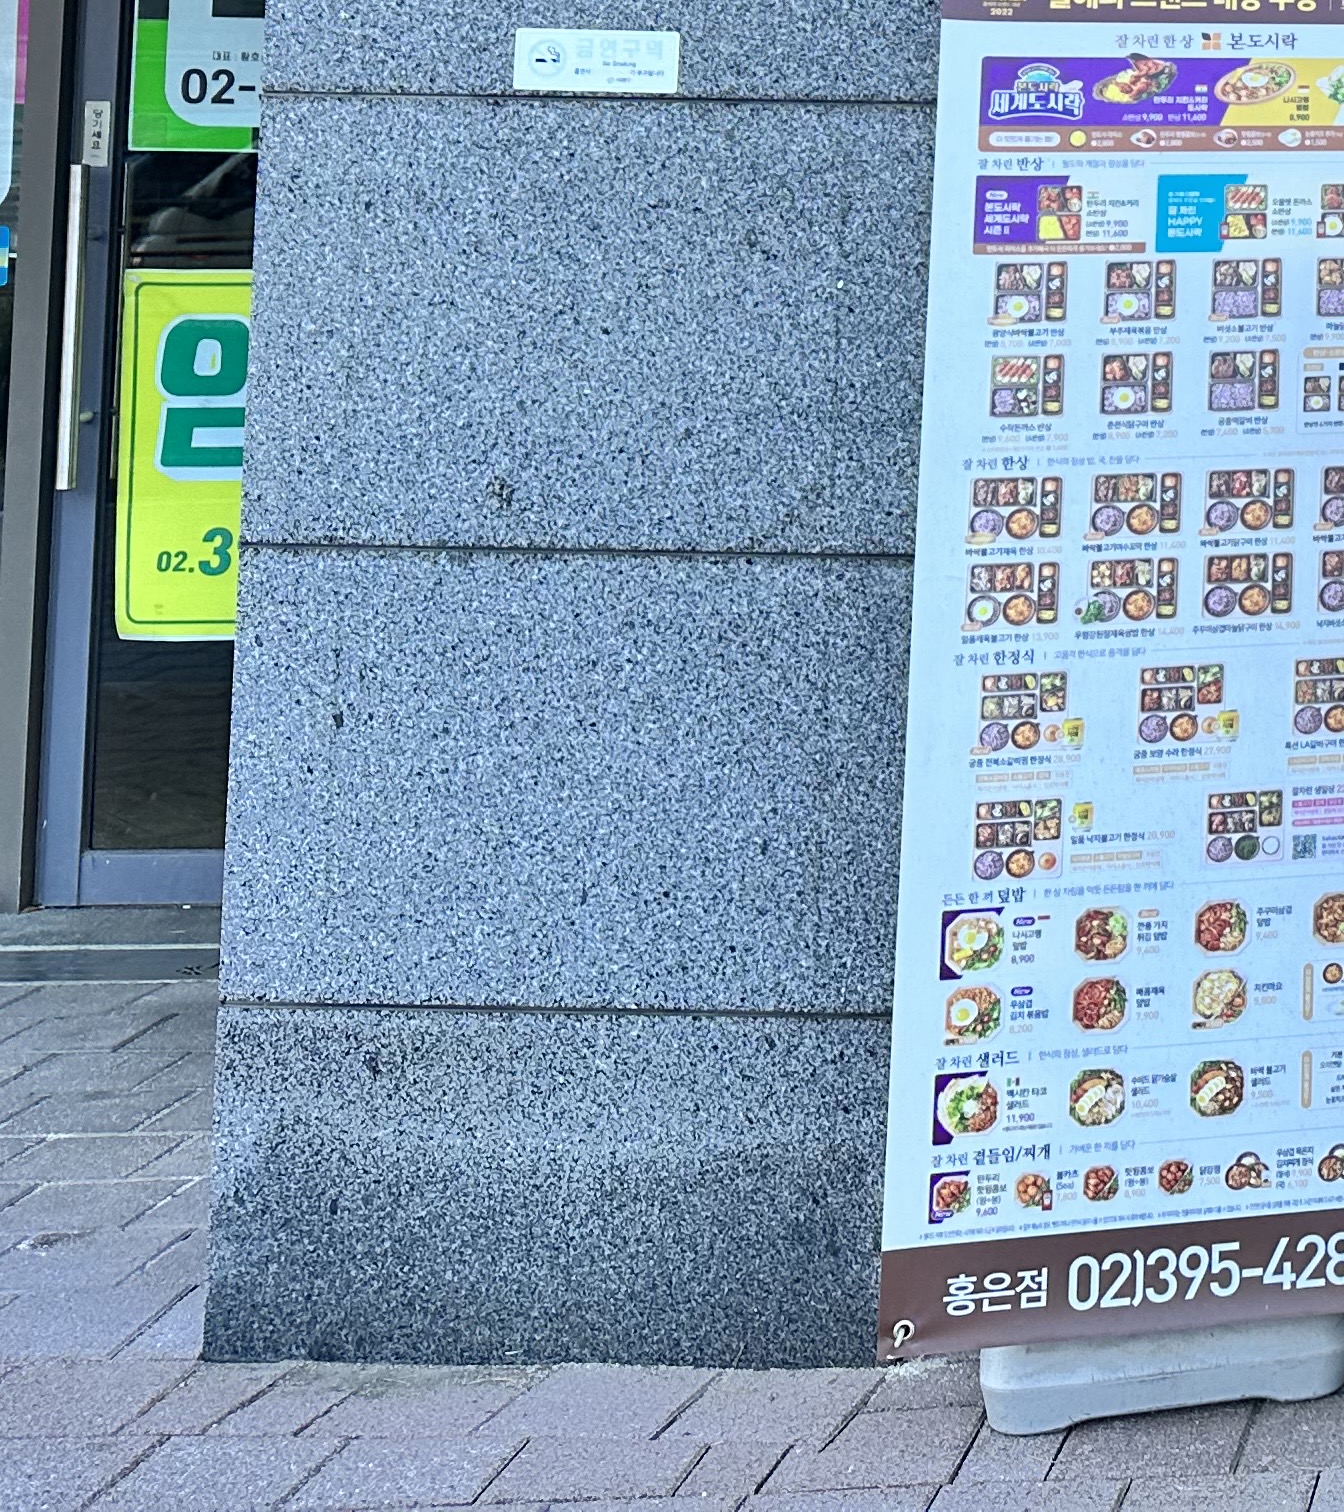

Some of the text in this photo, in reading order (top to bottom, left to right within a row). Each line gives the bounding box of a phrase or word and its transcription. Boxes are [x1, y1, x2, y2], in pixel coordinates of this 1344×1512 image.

[990, 7, 1014, 16] 2022
[1115, 34, 1129, 48] 잘
[1132, 33, 1159, 49] 차린
[1226, 32, 1298, 50] 본도시락
[992, 92, 1083, 117] 세계도시락
[992, 159, 1013, 171] 차린
[1016, 157, 1045, 172] 반상
[1167, 216, 1203, 227] HAPPY
[976, 458, 998, 471] 차린
[1001, 455, 1030, 471] 한상
[967, 653, 990, 665] 차린
[993, 649, 1035, 666] 한정식
[997, 886, 1027, 904] 덮밥
[1010, 954, 1035, 965] 8,900
[950, 1055, 973, 1068] 차린
[976, 1050, 1021, 1068] 샐러드
[1006, 1113, 1035, 1123] 11,900
[945, 1152, 969, 1166] 차린
[973, 1143, 1051, 1166] 곁들임/찌개
[975, 1206, 999, 1217] 9,600
[942, 1266, 1049, 1318] 홍은점
